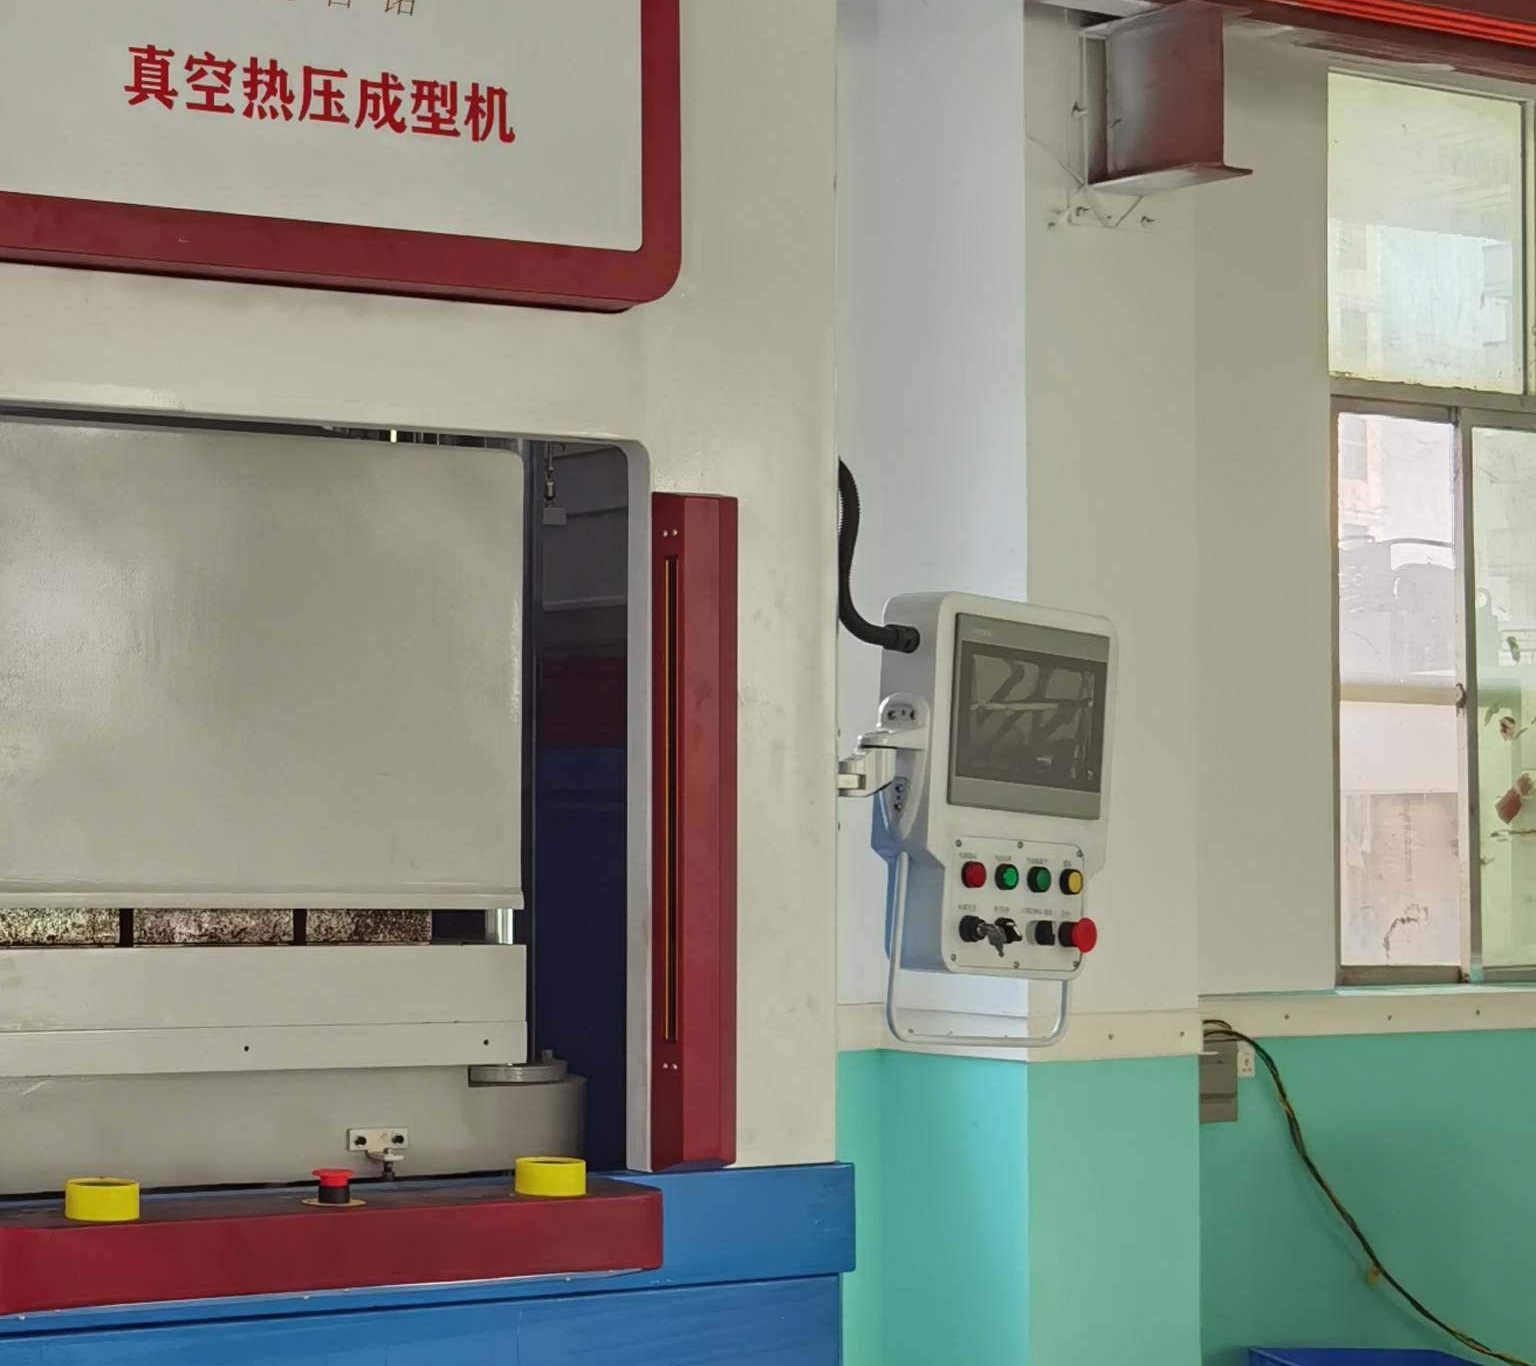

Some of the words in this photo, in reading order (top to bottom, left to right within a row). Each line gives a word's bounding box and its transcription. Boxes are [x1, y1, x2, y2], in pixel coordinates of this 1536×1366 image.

[123, 43, 517, 144] 真空热压成型机
